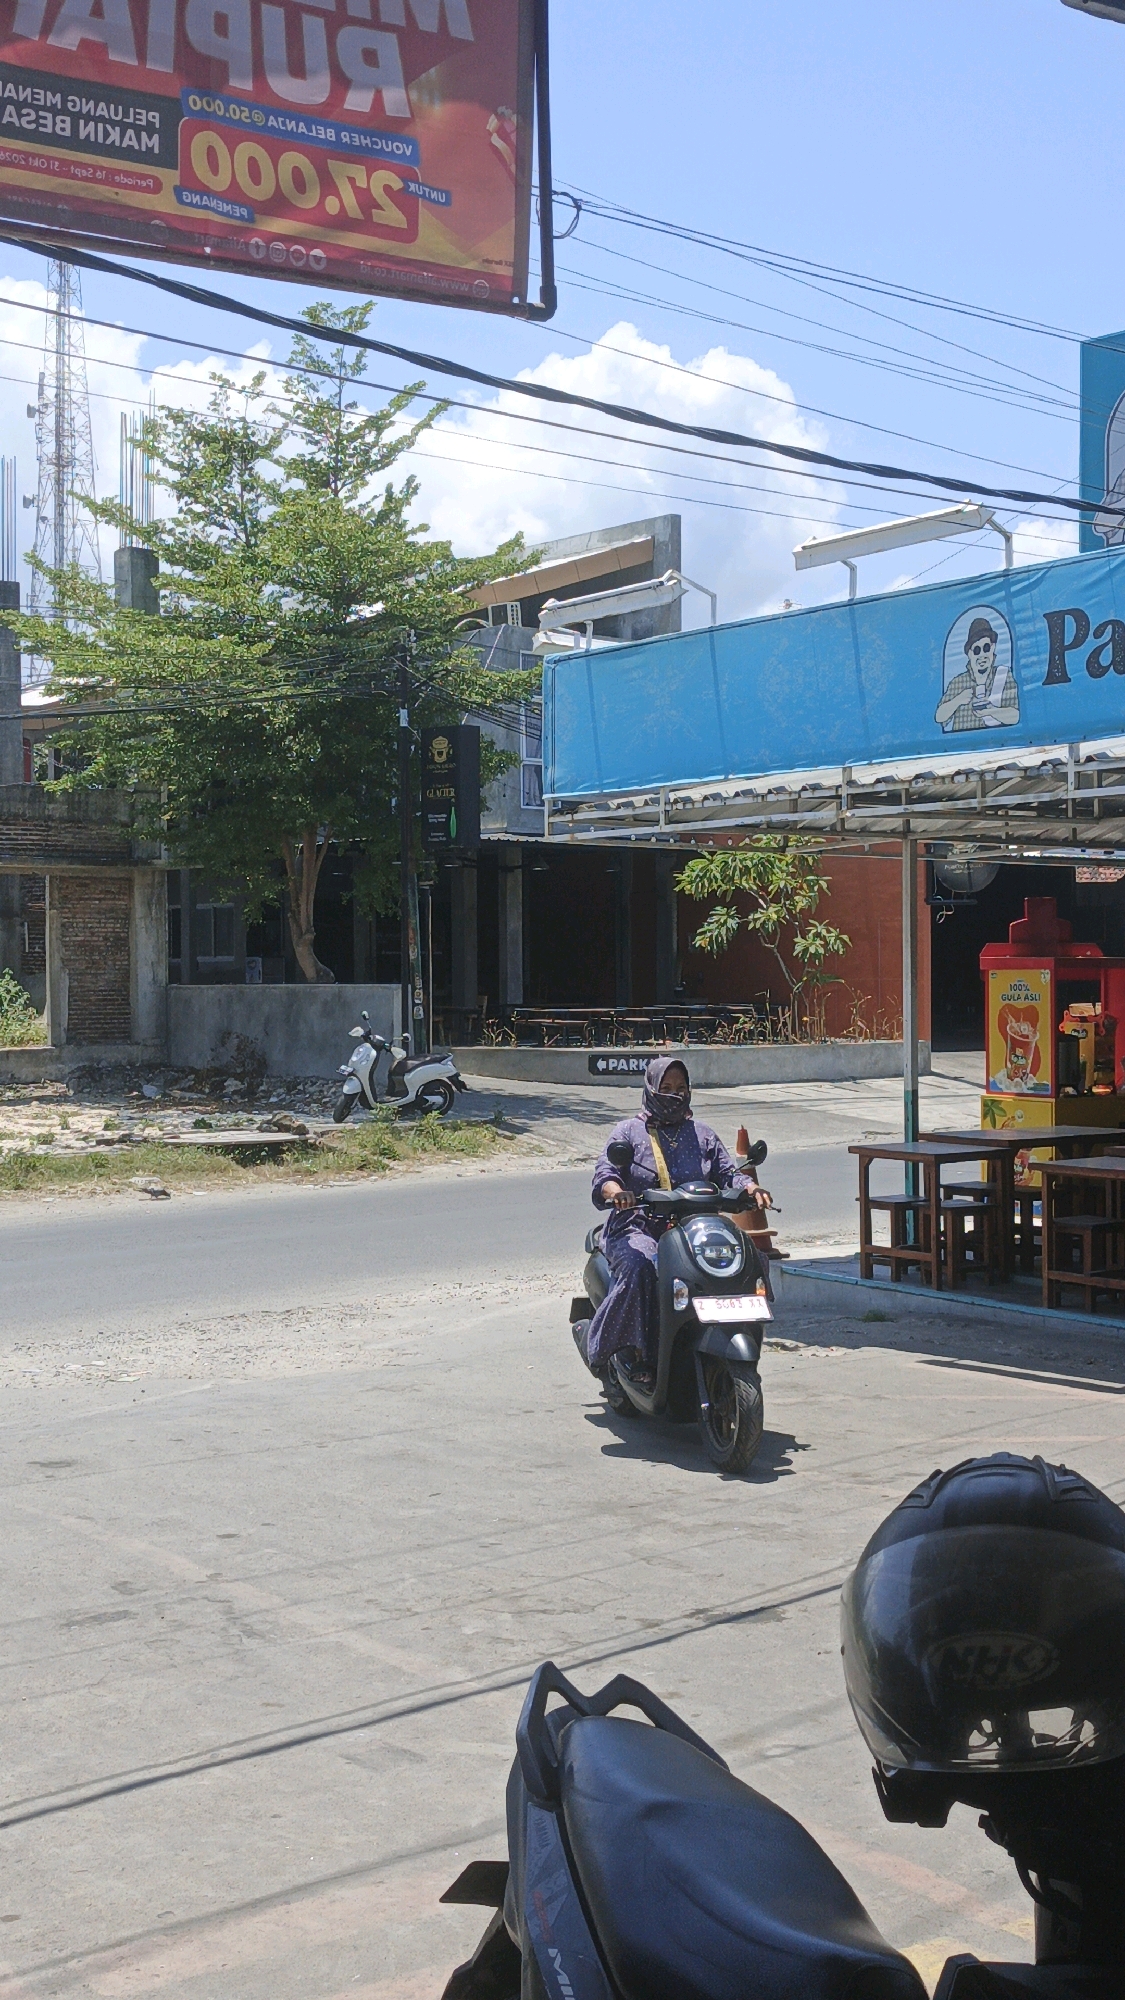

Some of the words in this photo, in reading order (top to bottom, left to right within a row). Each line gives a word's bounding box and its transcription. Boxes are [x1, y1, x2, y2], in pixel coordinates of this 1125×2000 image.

[1009, 983, 1031, 992] 100%
[1001, 993, 1022, 1002] GULA
[1023, 993, 1041, 1002] ASLI
[608, 1058, 655, 1071] PARK
